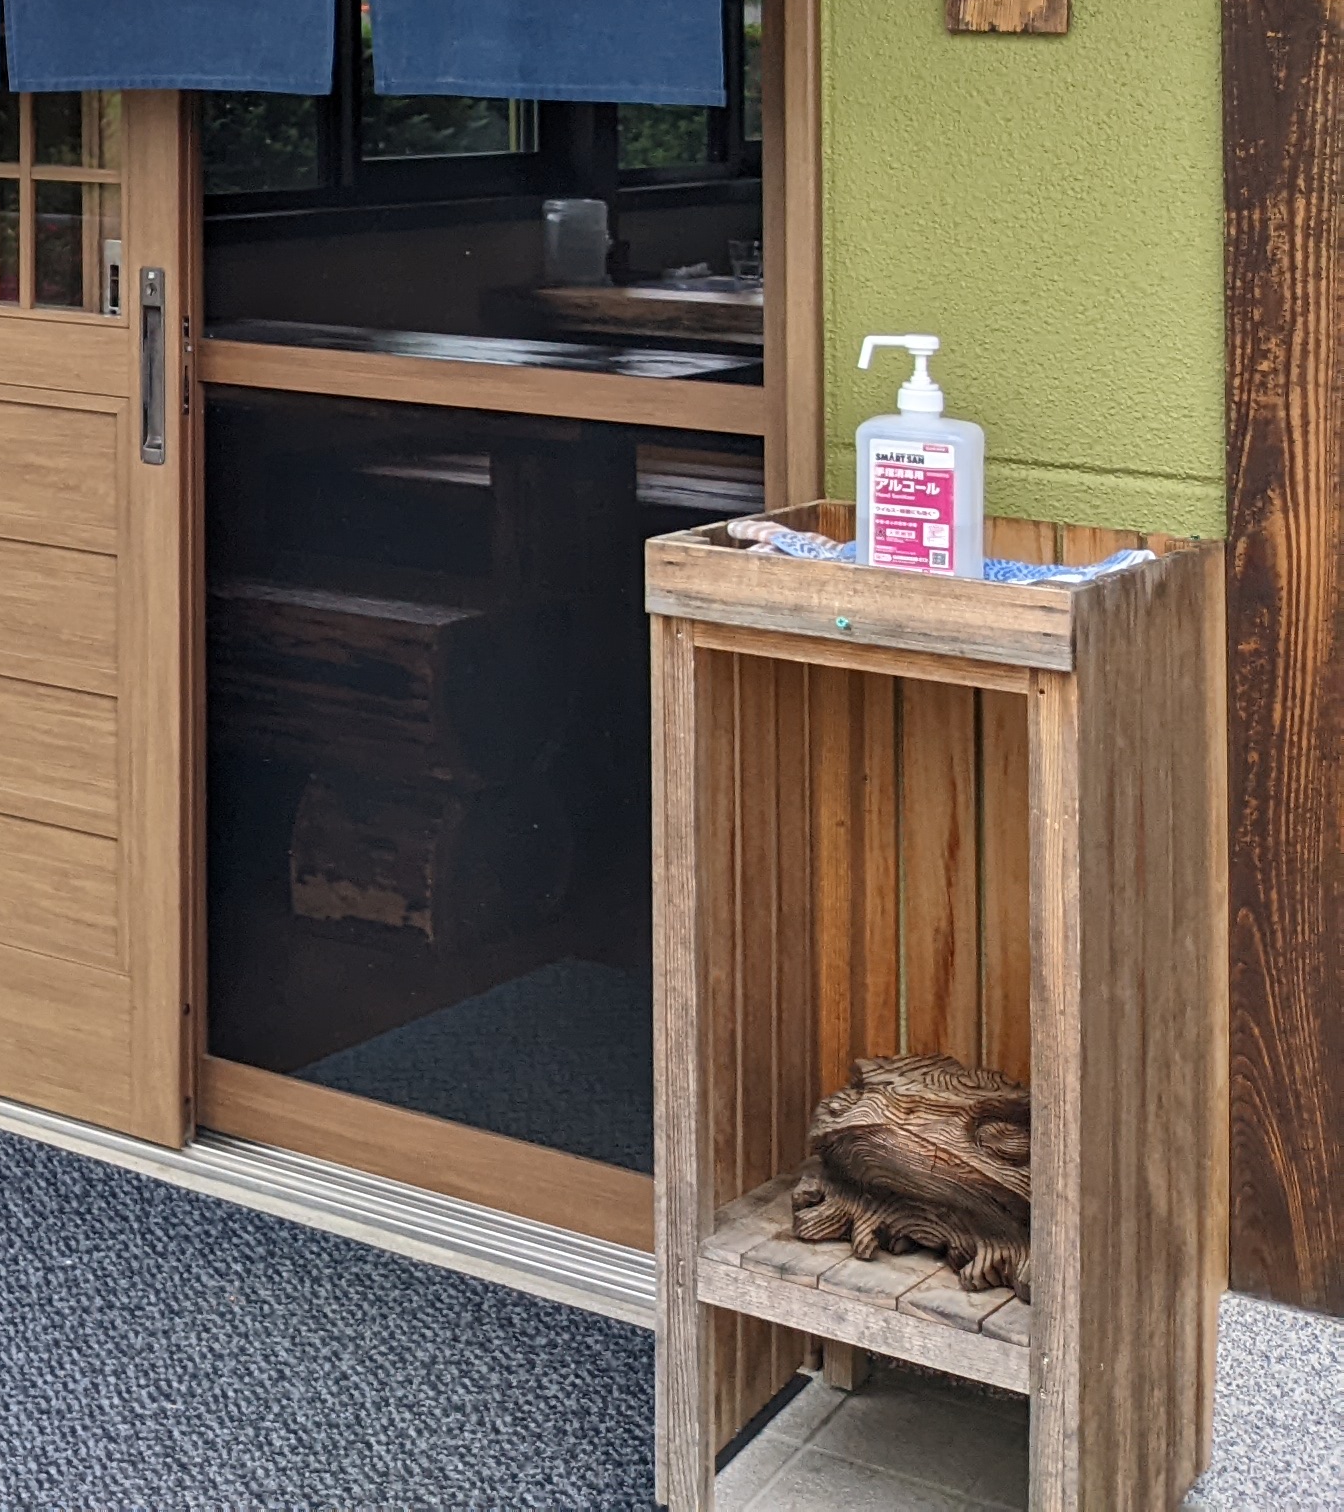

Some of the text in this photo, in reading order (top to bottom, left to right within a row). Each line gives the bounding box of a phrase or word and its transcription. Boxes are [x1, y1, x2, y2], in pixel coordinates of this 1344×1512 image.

[875, 452, 925, 465] SMART SAN
[875, 478, 941, 496] アルコール
